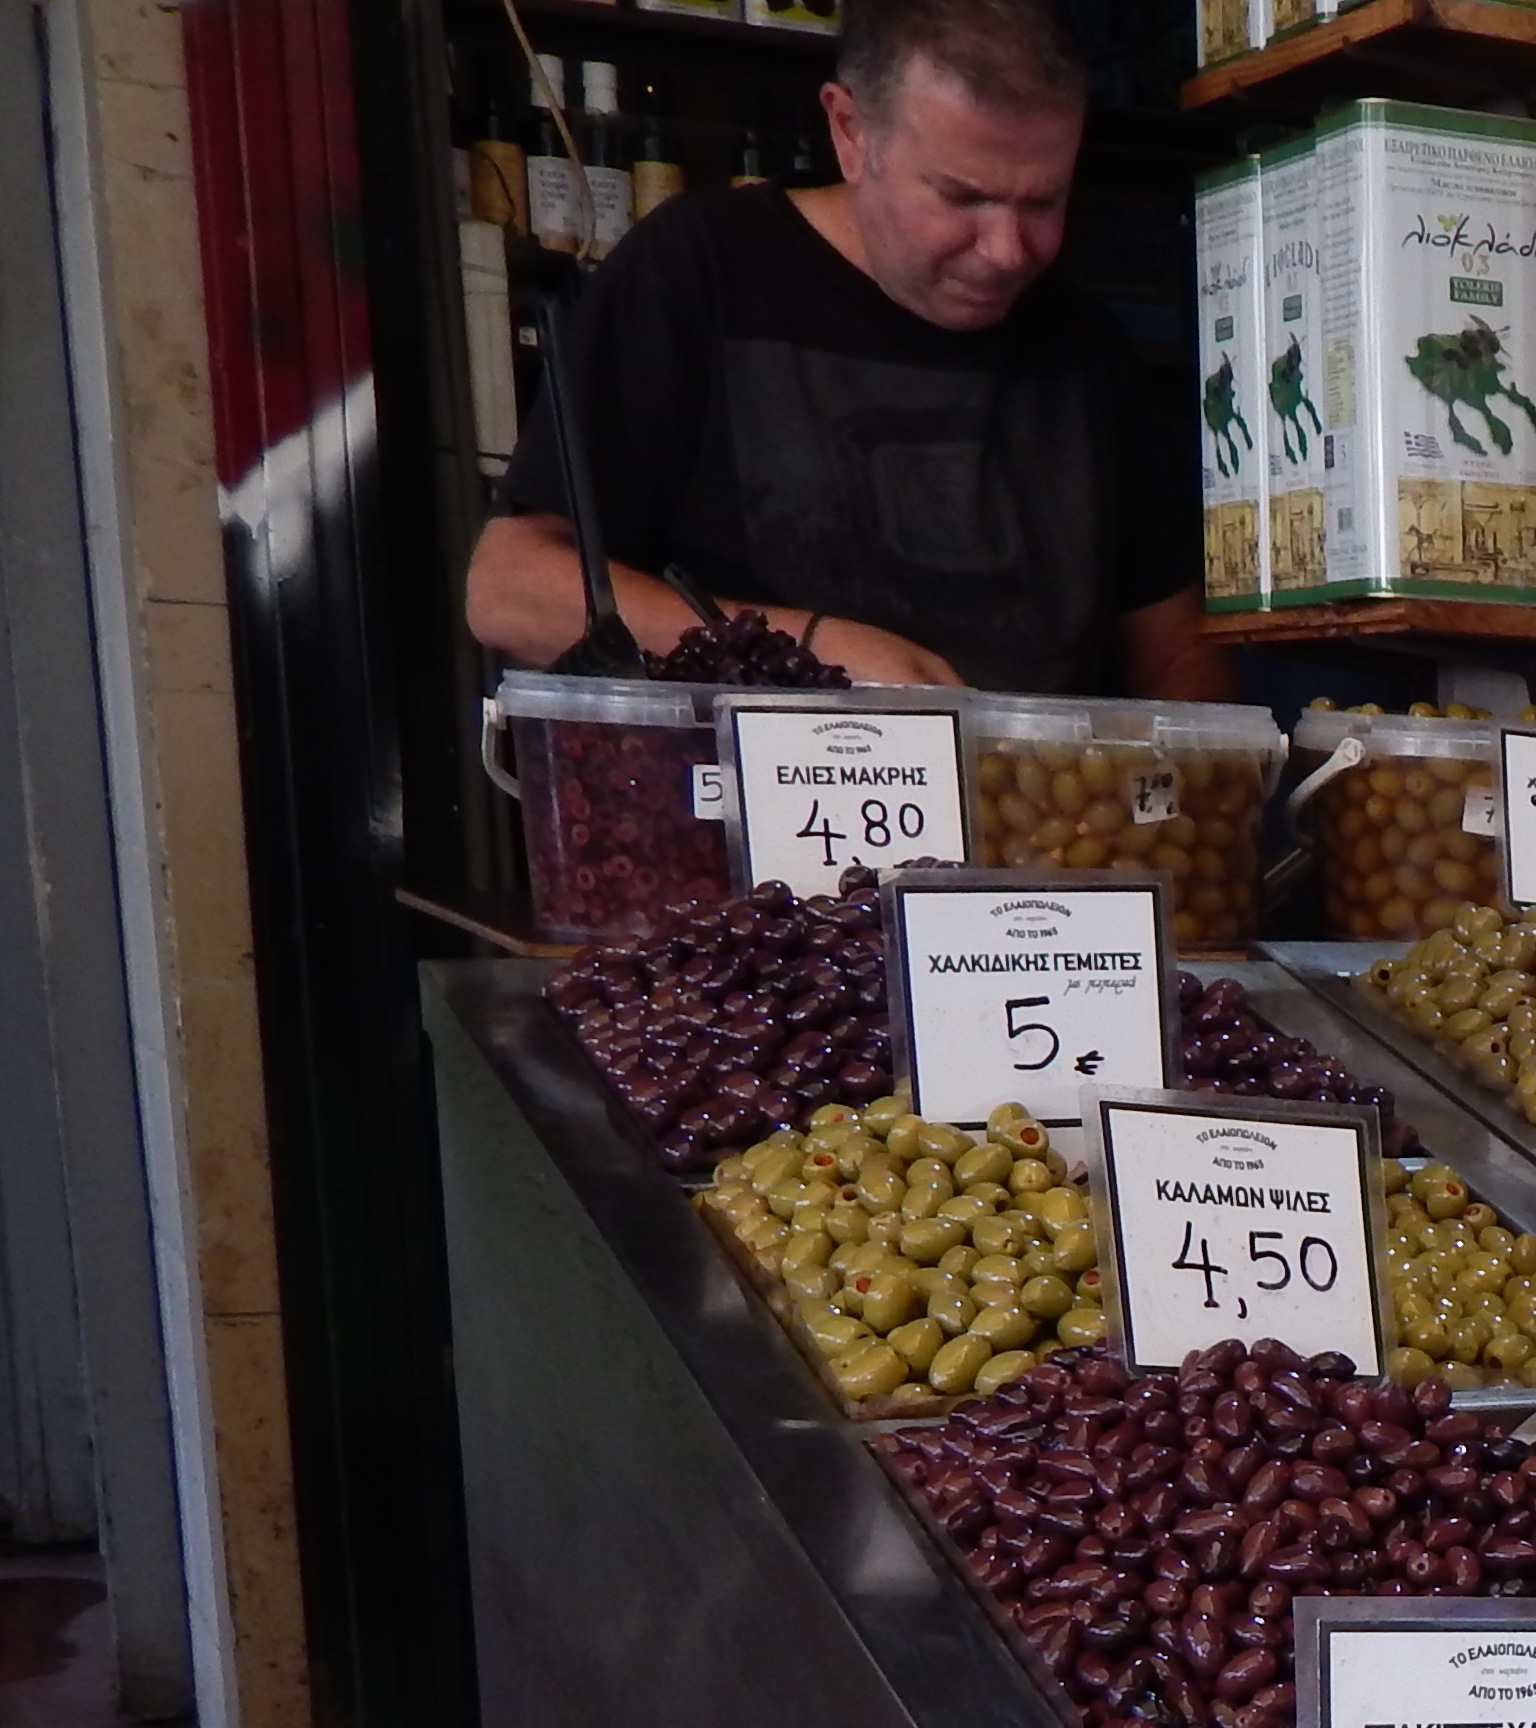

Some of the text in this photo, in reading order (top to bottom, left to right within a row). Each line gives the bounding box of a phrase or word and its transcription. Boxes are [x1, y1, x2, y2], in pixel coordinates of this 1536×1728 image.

[777, 766, 927, 786] ΕΛΙΕΣ ΜΑΚΡΗΣ
[796, 799, 924, 866] 4,80
[929, 953, 1143, 973] ΧΑΛΚΙΔΙΚΗΣ ΓΕΜΙΣΤΕΣ
[1004, 996, 1105, 1075] 5 €
[1156, 1179, 1331, 1214] ΚΑΛΑΜΩΝ ΨΙΛΕΣ
[1171, 1221, 1338, 1319] 4,50
[1448, 1653, 1467, 1669] ΤΟ
[1468, 1685, 1496, 1700] ΑΠΟ
[1498, 1687, 1513, 1700] ΤΟ
